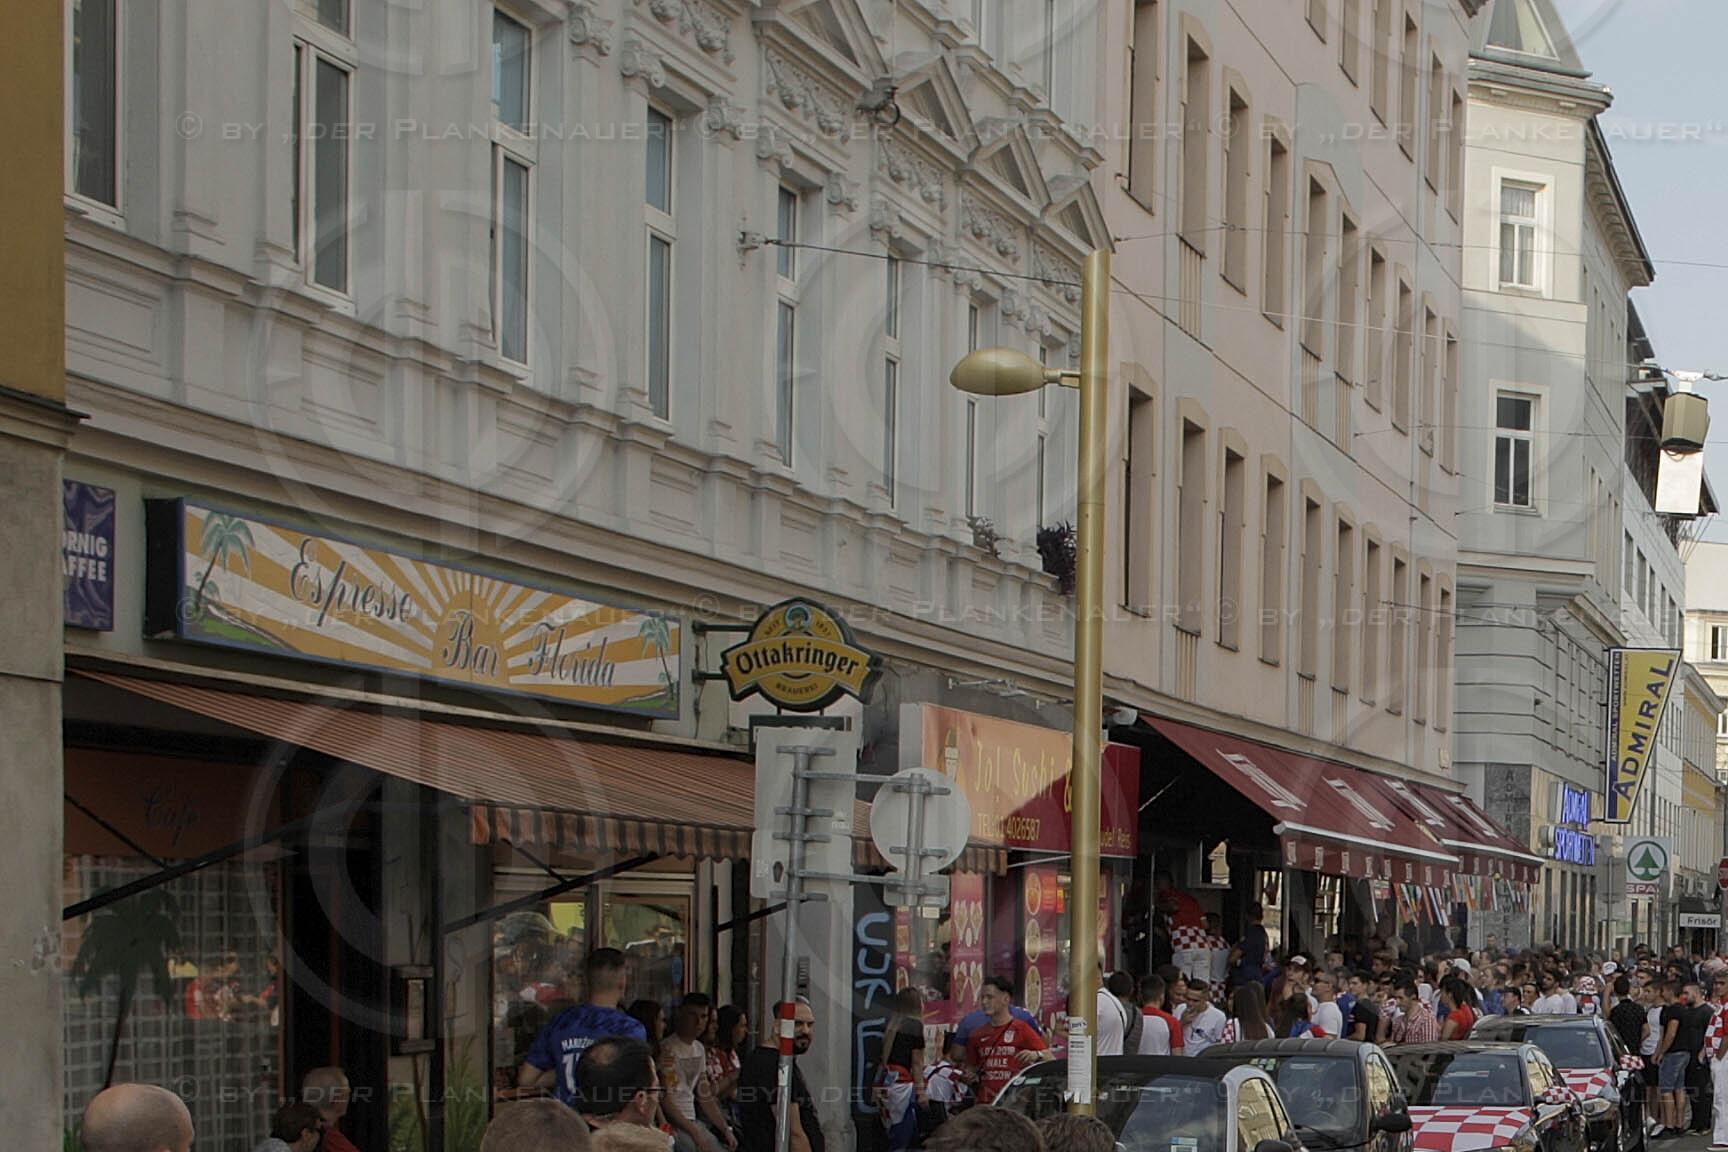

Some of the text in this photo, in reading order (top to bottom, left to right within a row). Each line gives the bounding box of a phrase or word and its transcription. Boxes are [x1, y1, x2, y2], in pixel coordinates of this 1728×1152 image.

[442, 610, 498, 677] Bar
[528, 621, 616, 687] Florida
[736, 642, 860, 675] Ottakringer
[1612, 659, 1675, 801] ADMIRAL
[1012, 747, 1055, 798] Sushi
[1687, 915, 1719, 926] Frisör
